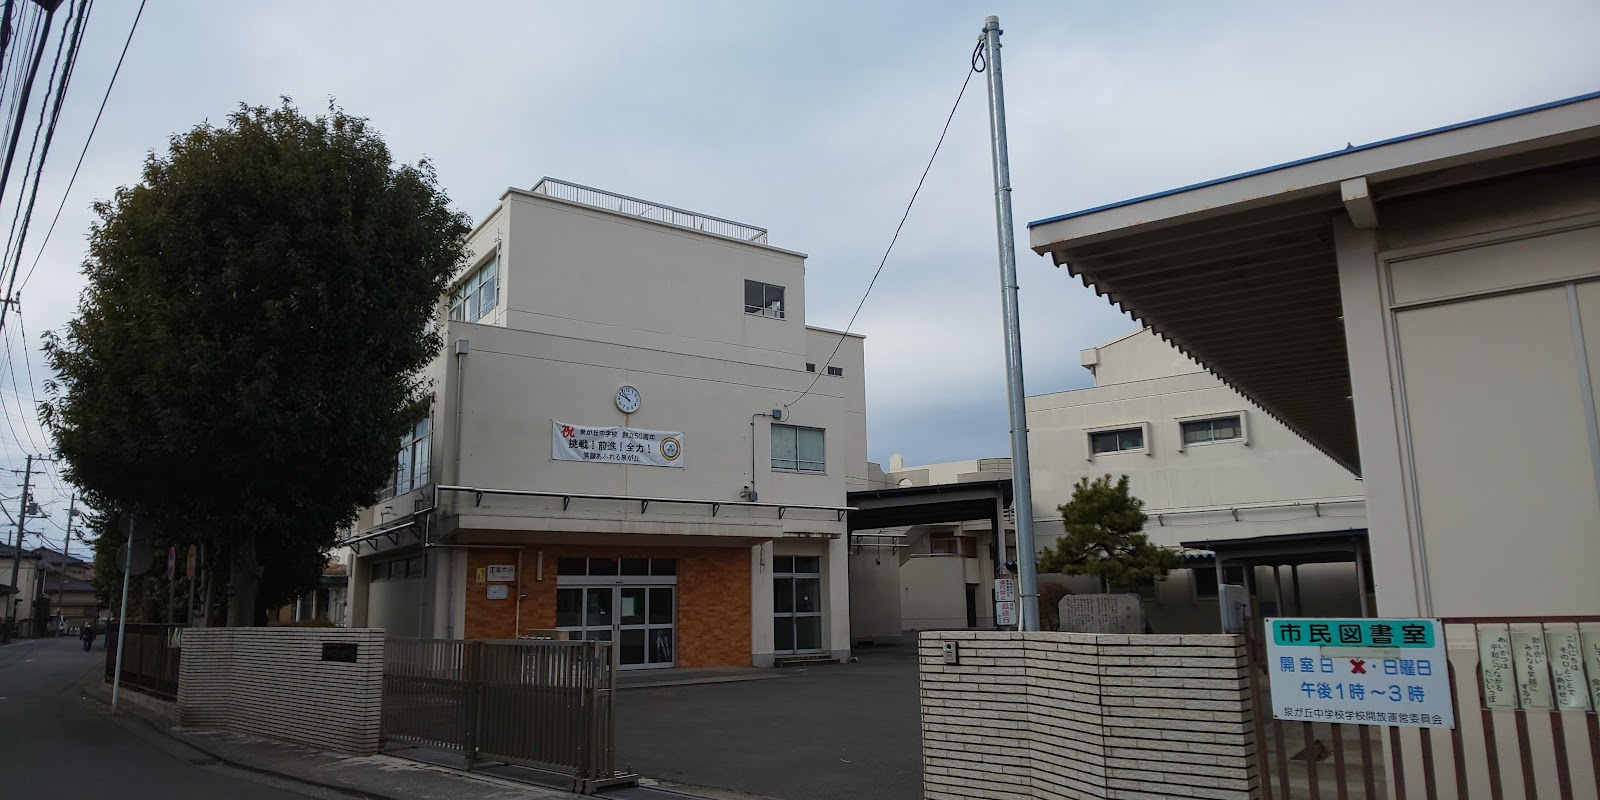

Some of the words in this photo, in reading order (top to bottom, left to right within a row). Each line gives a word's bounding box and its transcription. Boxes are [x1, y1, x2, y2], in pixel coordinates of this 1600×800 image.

[561, 424, 575, 438] 祝
[579, 429, 618, 438] 泉が丘中学校
[1279, 623, 1428, 645] 市民図書室
[1567, 635, 1580, 671] こんにちは
[1279, 656, 1334, 674] 開室日
[1284, 706, 1443, 726] 泉が丘中学校学校開放運営委員会
